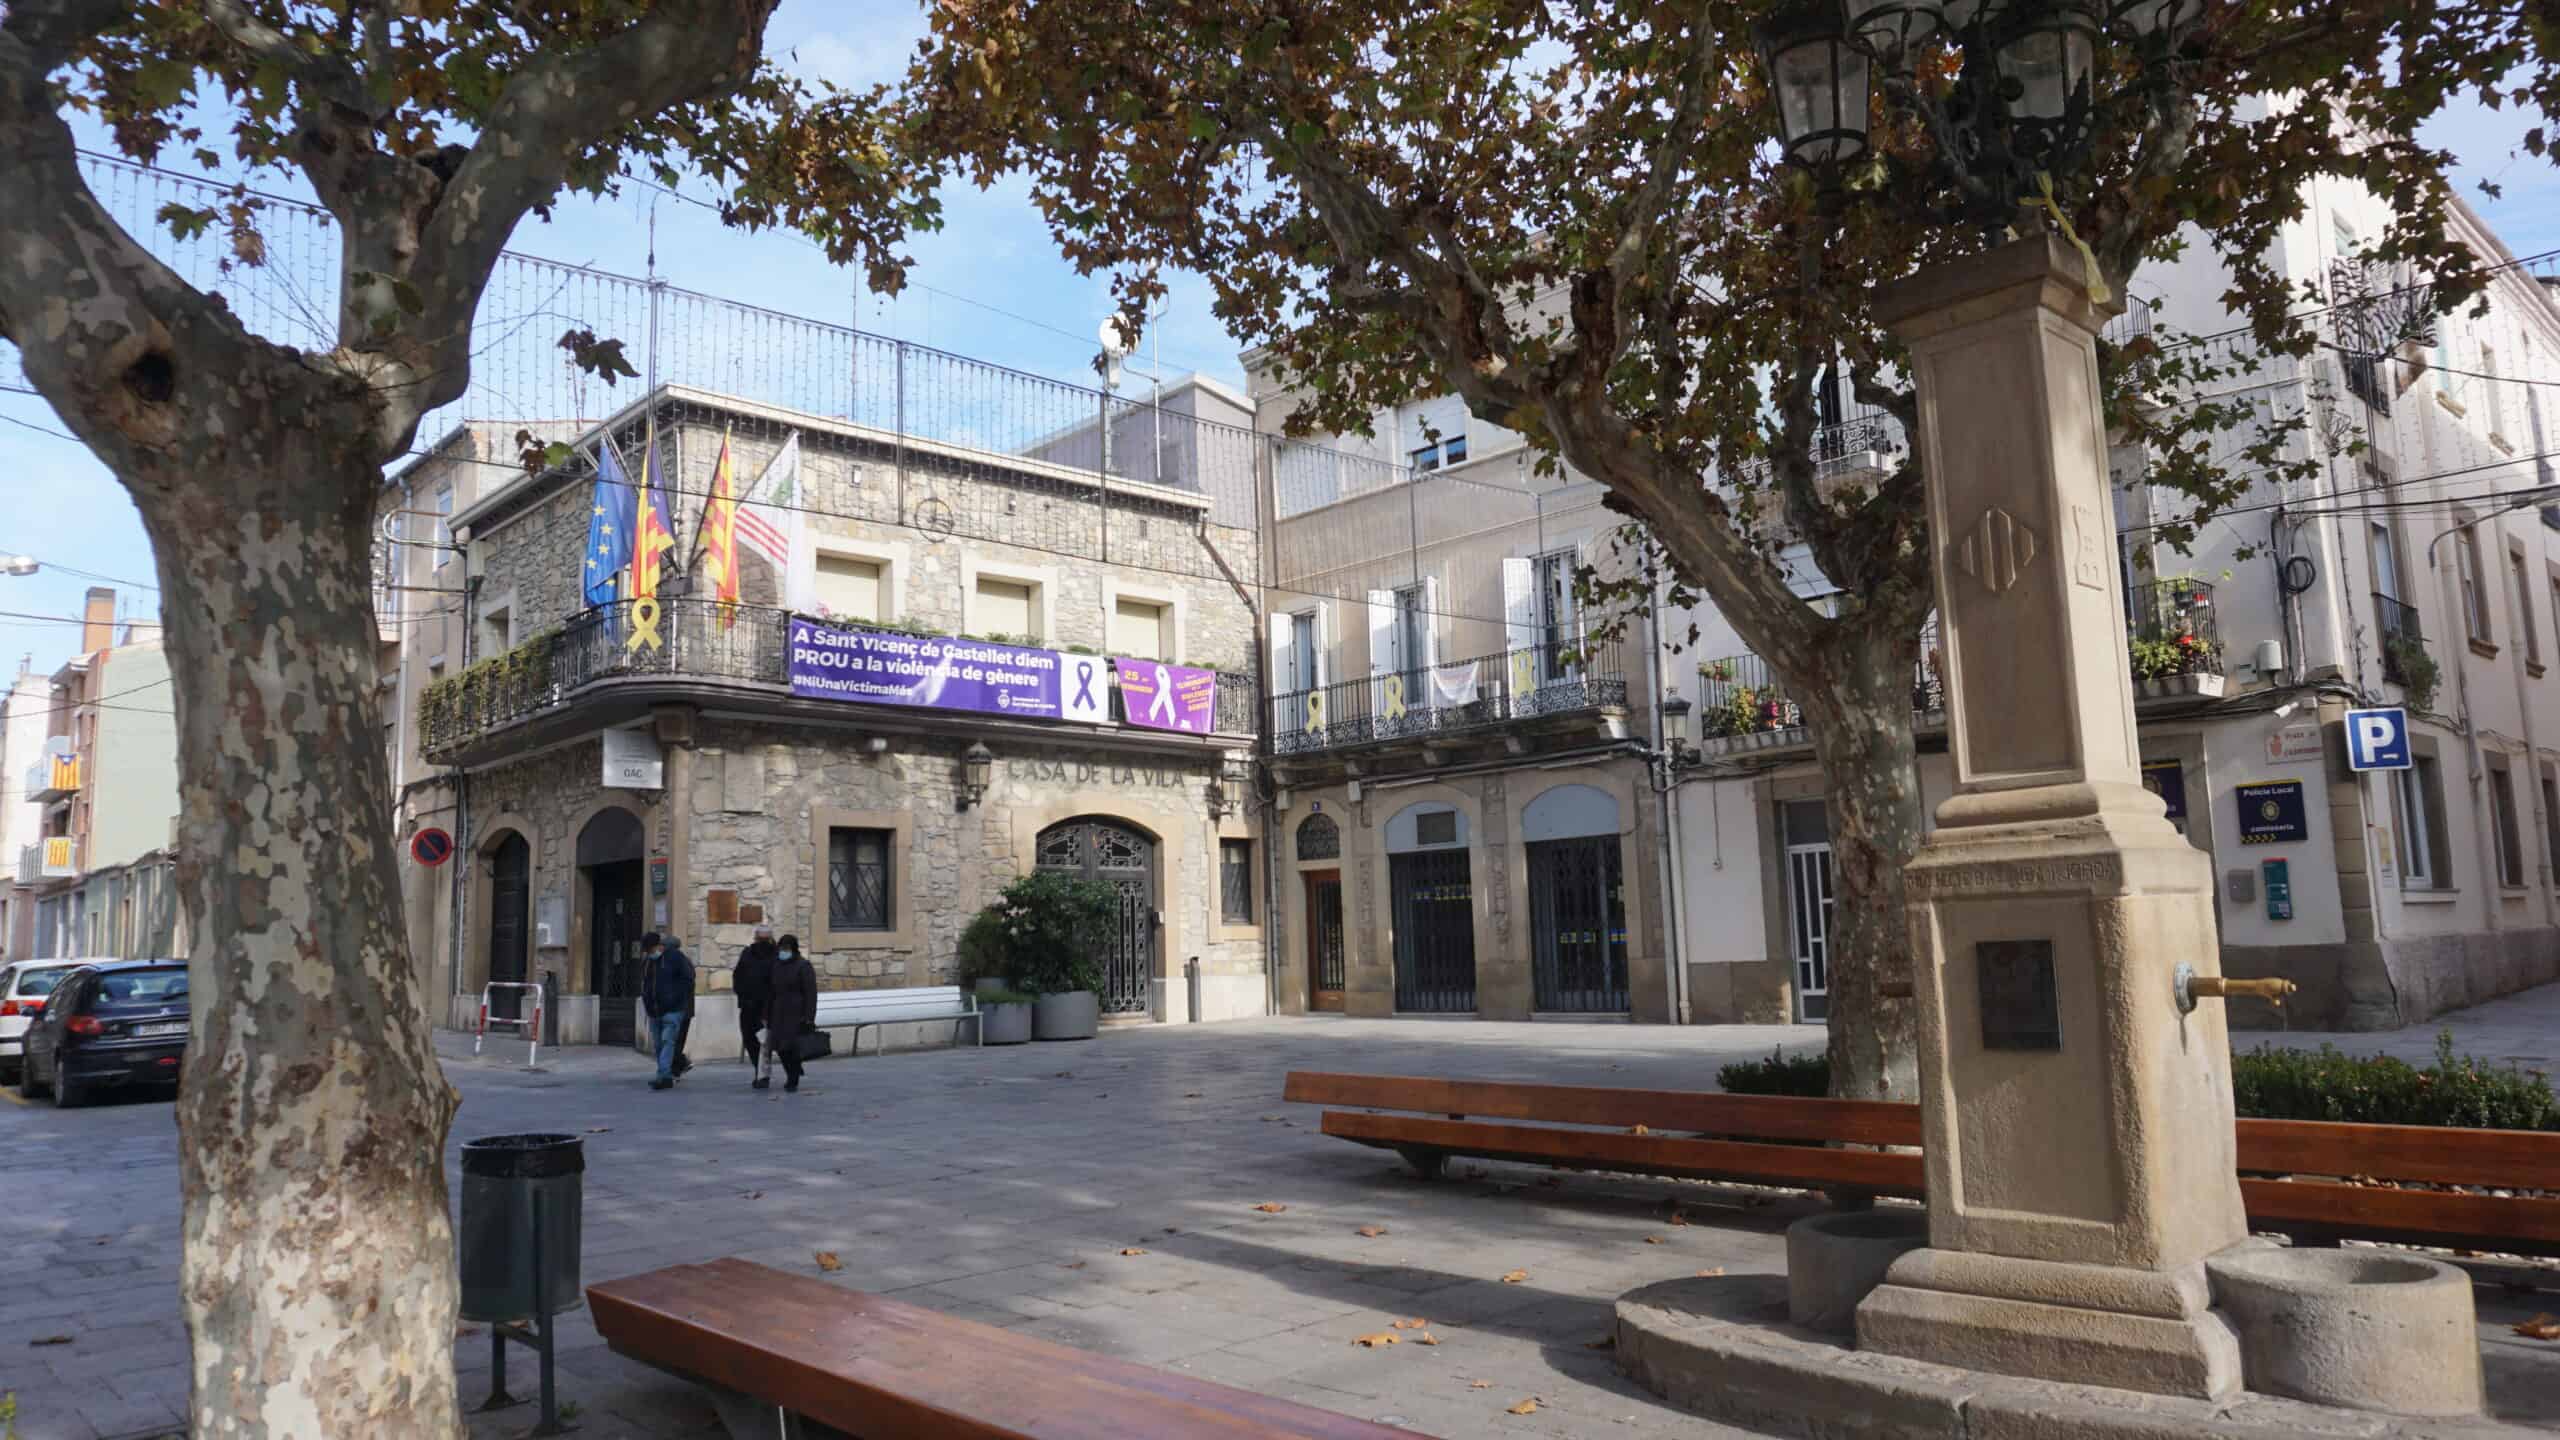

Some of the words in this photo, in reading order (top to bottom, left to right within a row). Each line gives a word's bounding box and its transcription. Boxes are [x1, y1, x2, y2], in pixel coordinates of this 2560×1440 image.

[794, 628, 810, 643] A
[814, 630, 858, 649] Sant
[861, 637, 919, 659] Vicenç
[920, 642, 940, 657] de
[943, 644, 1013, 665] Castellet
[1015, 653, 1054, 670] diem
[794, 648, 849, 668] PROU
[852, 657, 863, 670] a
[867, 656, 882, 672] la
[962, 665, 983, 681] de
[985, 668, 1039, 687] gènere
[2358, 716, 2395, 763] P
[1007, 760, 1067, 783] CASA
[1076, 763, 1101, 784] DE
[1111, 766, 1136, 786] LA
[1142, 768, 1185, 788] VILA
